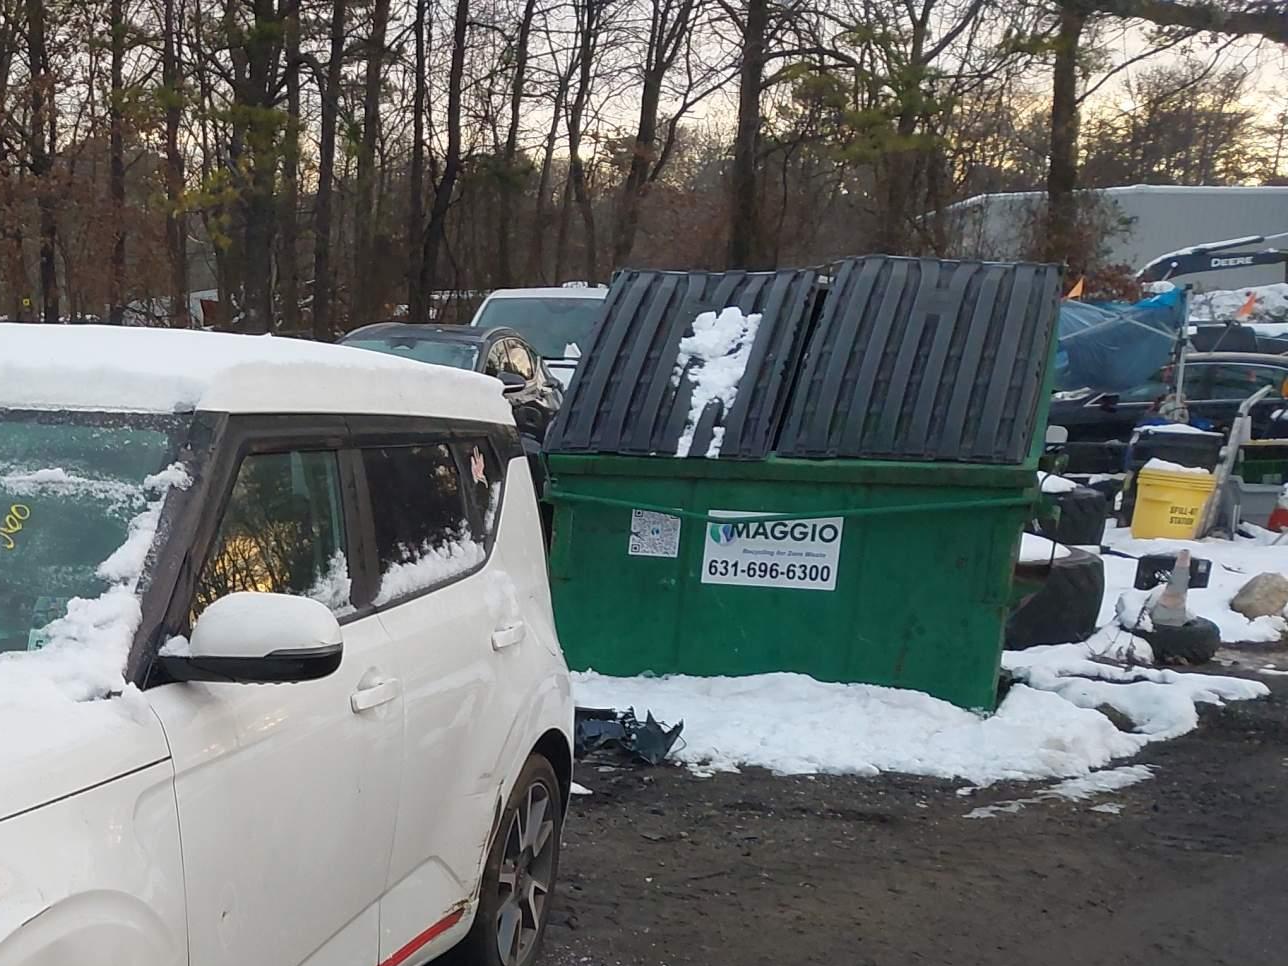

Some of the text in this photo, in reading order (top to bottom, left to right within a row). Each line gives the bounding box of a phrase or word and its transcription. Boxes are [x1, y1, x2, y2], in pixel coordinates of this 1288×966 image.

[1211, 256, 1253, 267] DEERE
[732, 521, 839, 543] MAGGIO
[708, 559, 831, 582] 631-696-6300
